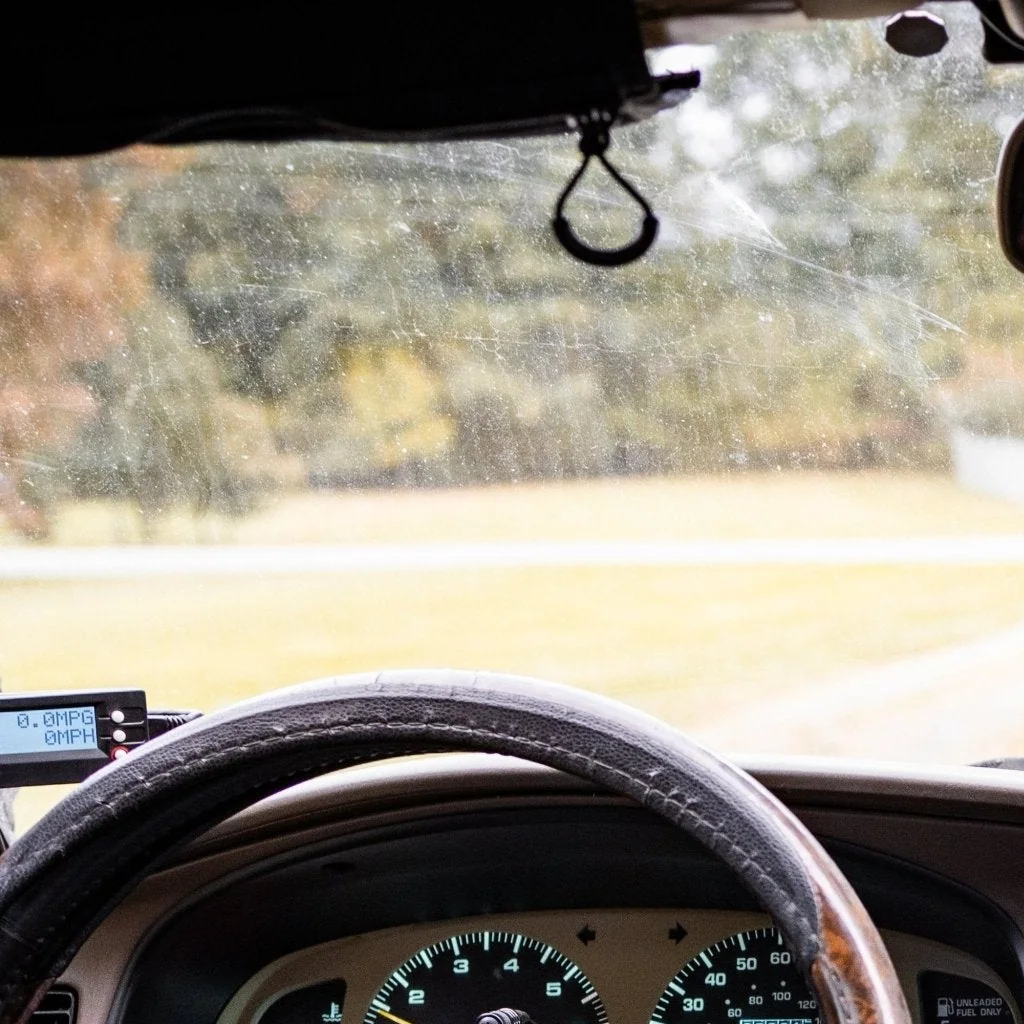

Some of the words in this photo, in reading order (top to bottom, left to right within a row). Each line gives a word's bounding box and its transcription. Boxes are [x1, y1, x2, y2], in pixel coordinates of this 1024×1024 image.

[17, 709, 94, 729] 0.0MPG
[44, 728, 95, 746] 0MPH
[736, 957, 758, 971] 50
[770, 951, 791, 965] 60
[453, 959, 469, 974] 3
[503, 958, 520, 973] 4
[704, 972, 727, 987] 40
[546, 982, 562, 997] 5
[771, 991, 792, 1001] 100
[408, 989, 425, 1005] 2
[748, 995, 764, 1006] 80
[956, 998, 1003, 1007] UNLEADED
[683, 998, 704, 1012] 30
[727, 1008, 742, 1018] 60
[956, 1008, 977, 1017] FUEL
[980, 1008, 1002, 1017] ONLY
